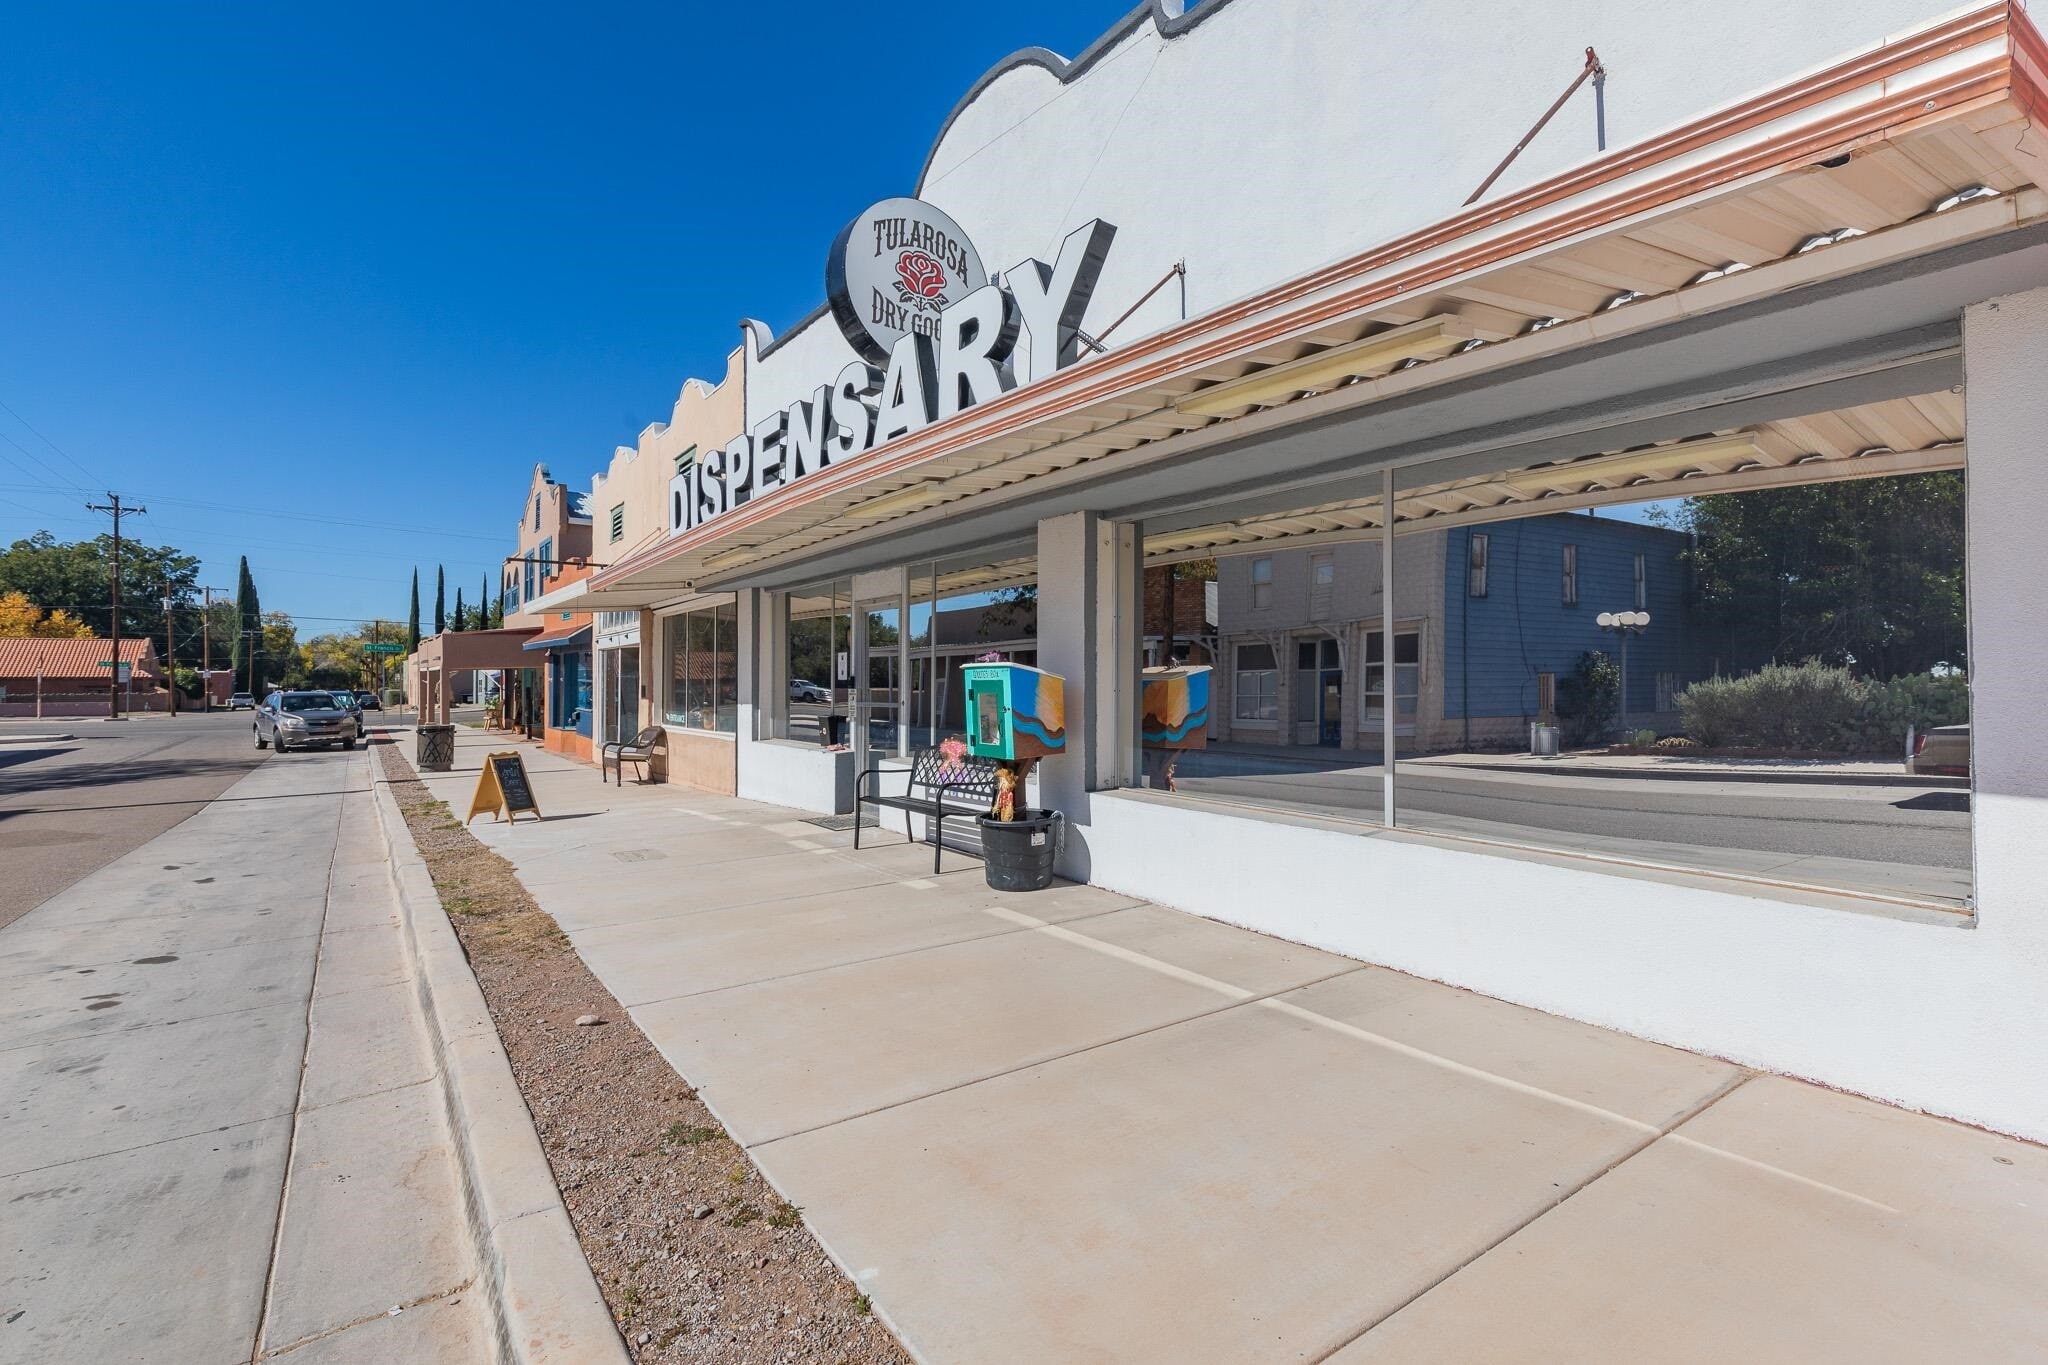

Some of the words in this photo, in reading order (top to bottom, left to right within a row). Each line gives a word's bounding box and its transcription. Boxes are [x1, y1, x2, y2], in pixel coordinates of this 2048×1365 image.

[873, 217, 968, 288] TULAROSA
[872, 285, 909, 332] DRY
[911, 313, 941, 341] GOO
[669, 218, 1117, 538] DISPENSARY
